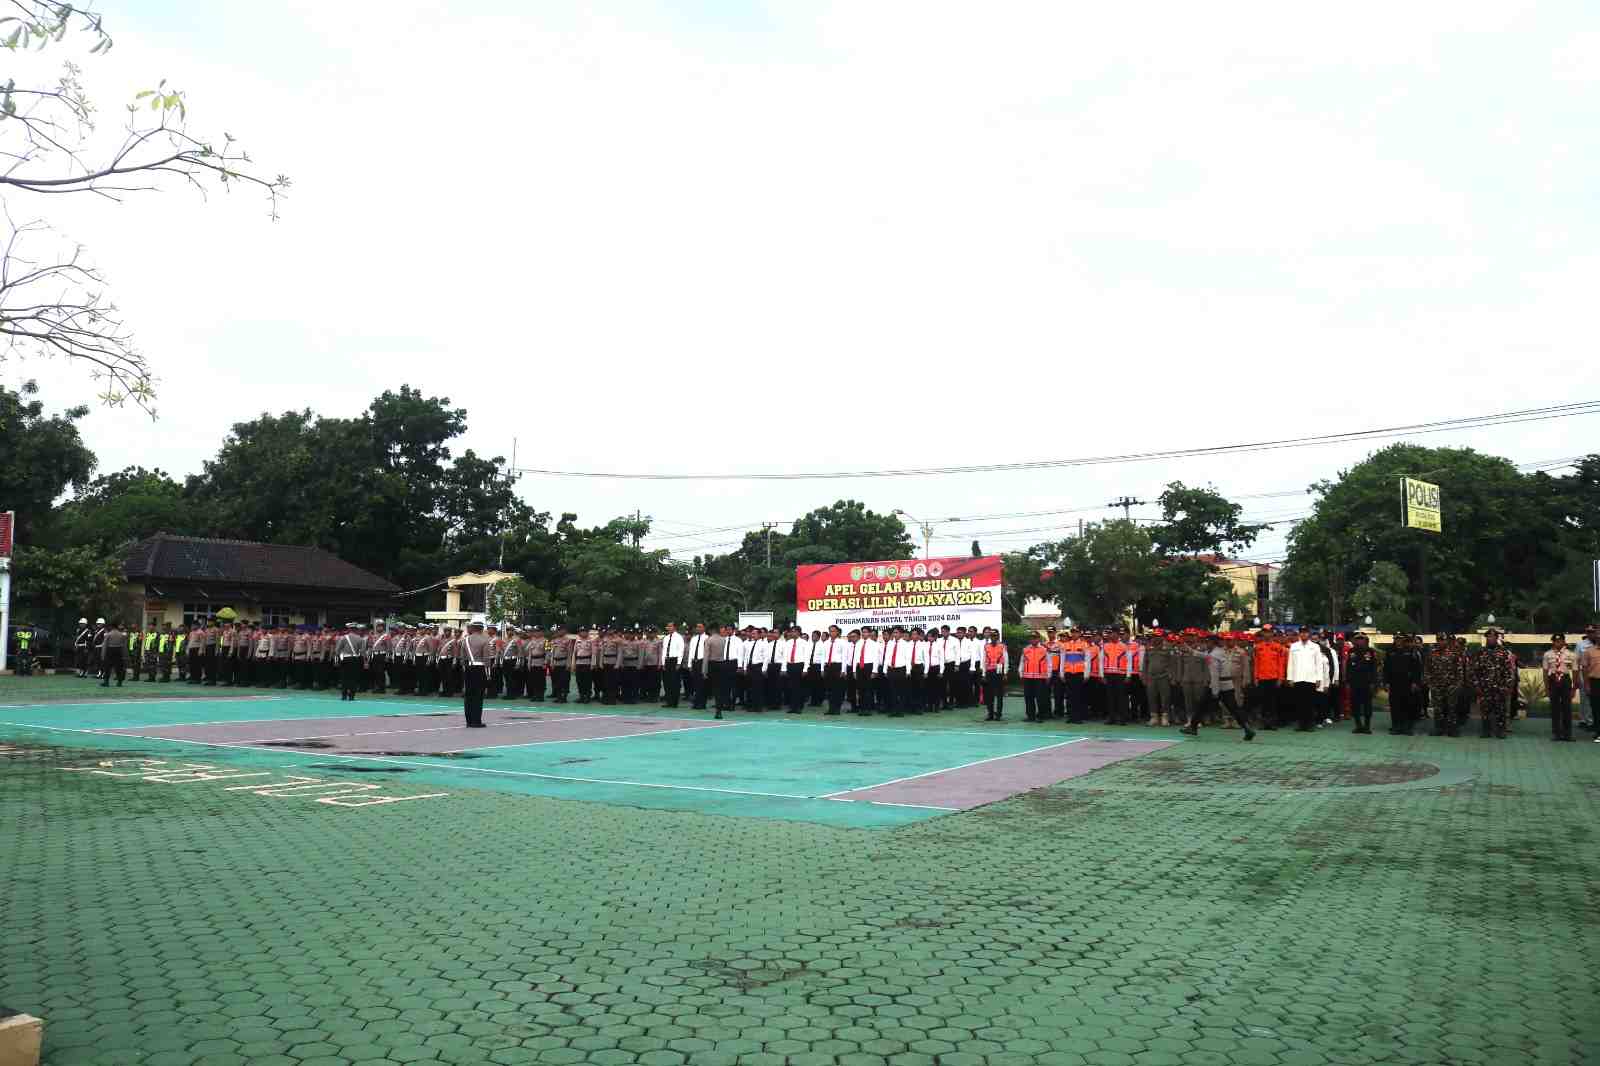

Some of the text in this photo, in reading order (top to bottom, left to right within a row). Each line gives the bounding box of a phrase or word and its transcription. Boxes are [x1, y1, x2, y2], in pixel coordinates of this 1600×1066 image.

[825, 577, 972, 597] APEL GELAR PASUKAN
[808, 590, 992, 611] OPERASI LILIN LODAYA 2024
